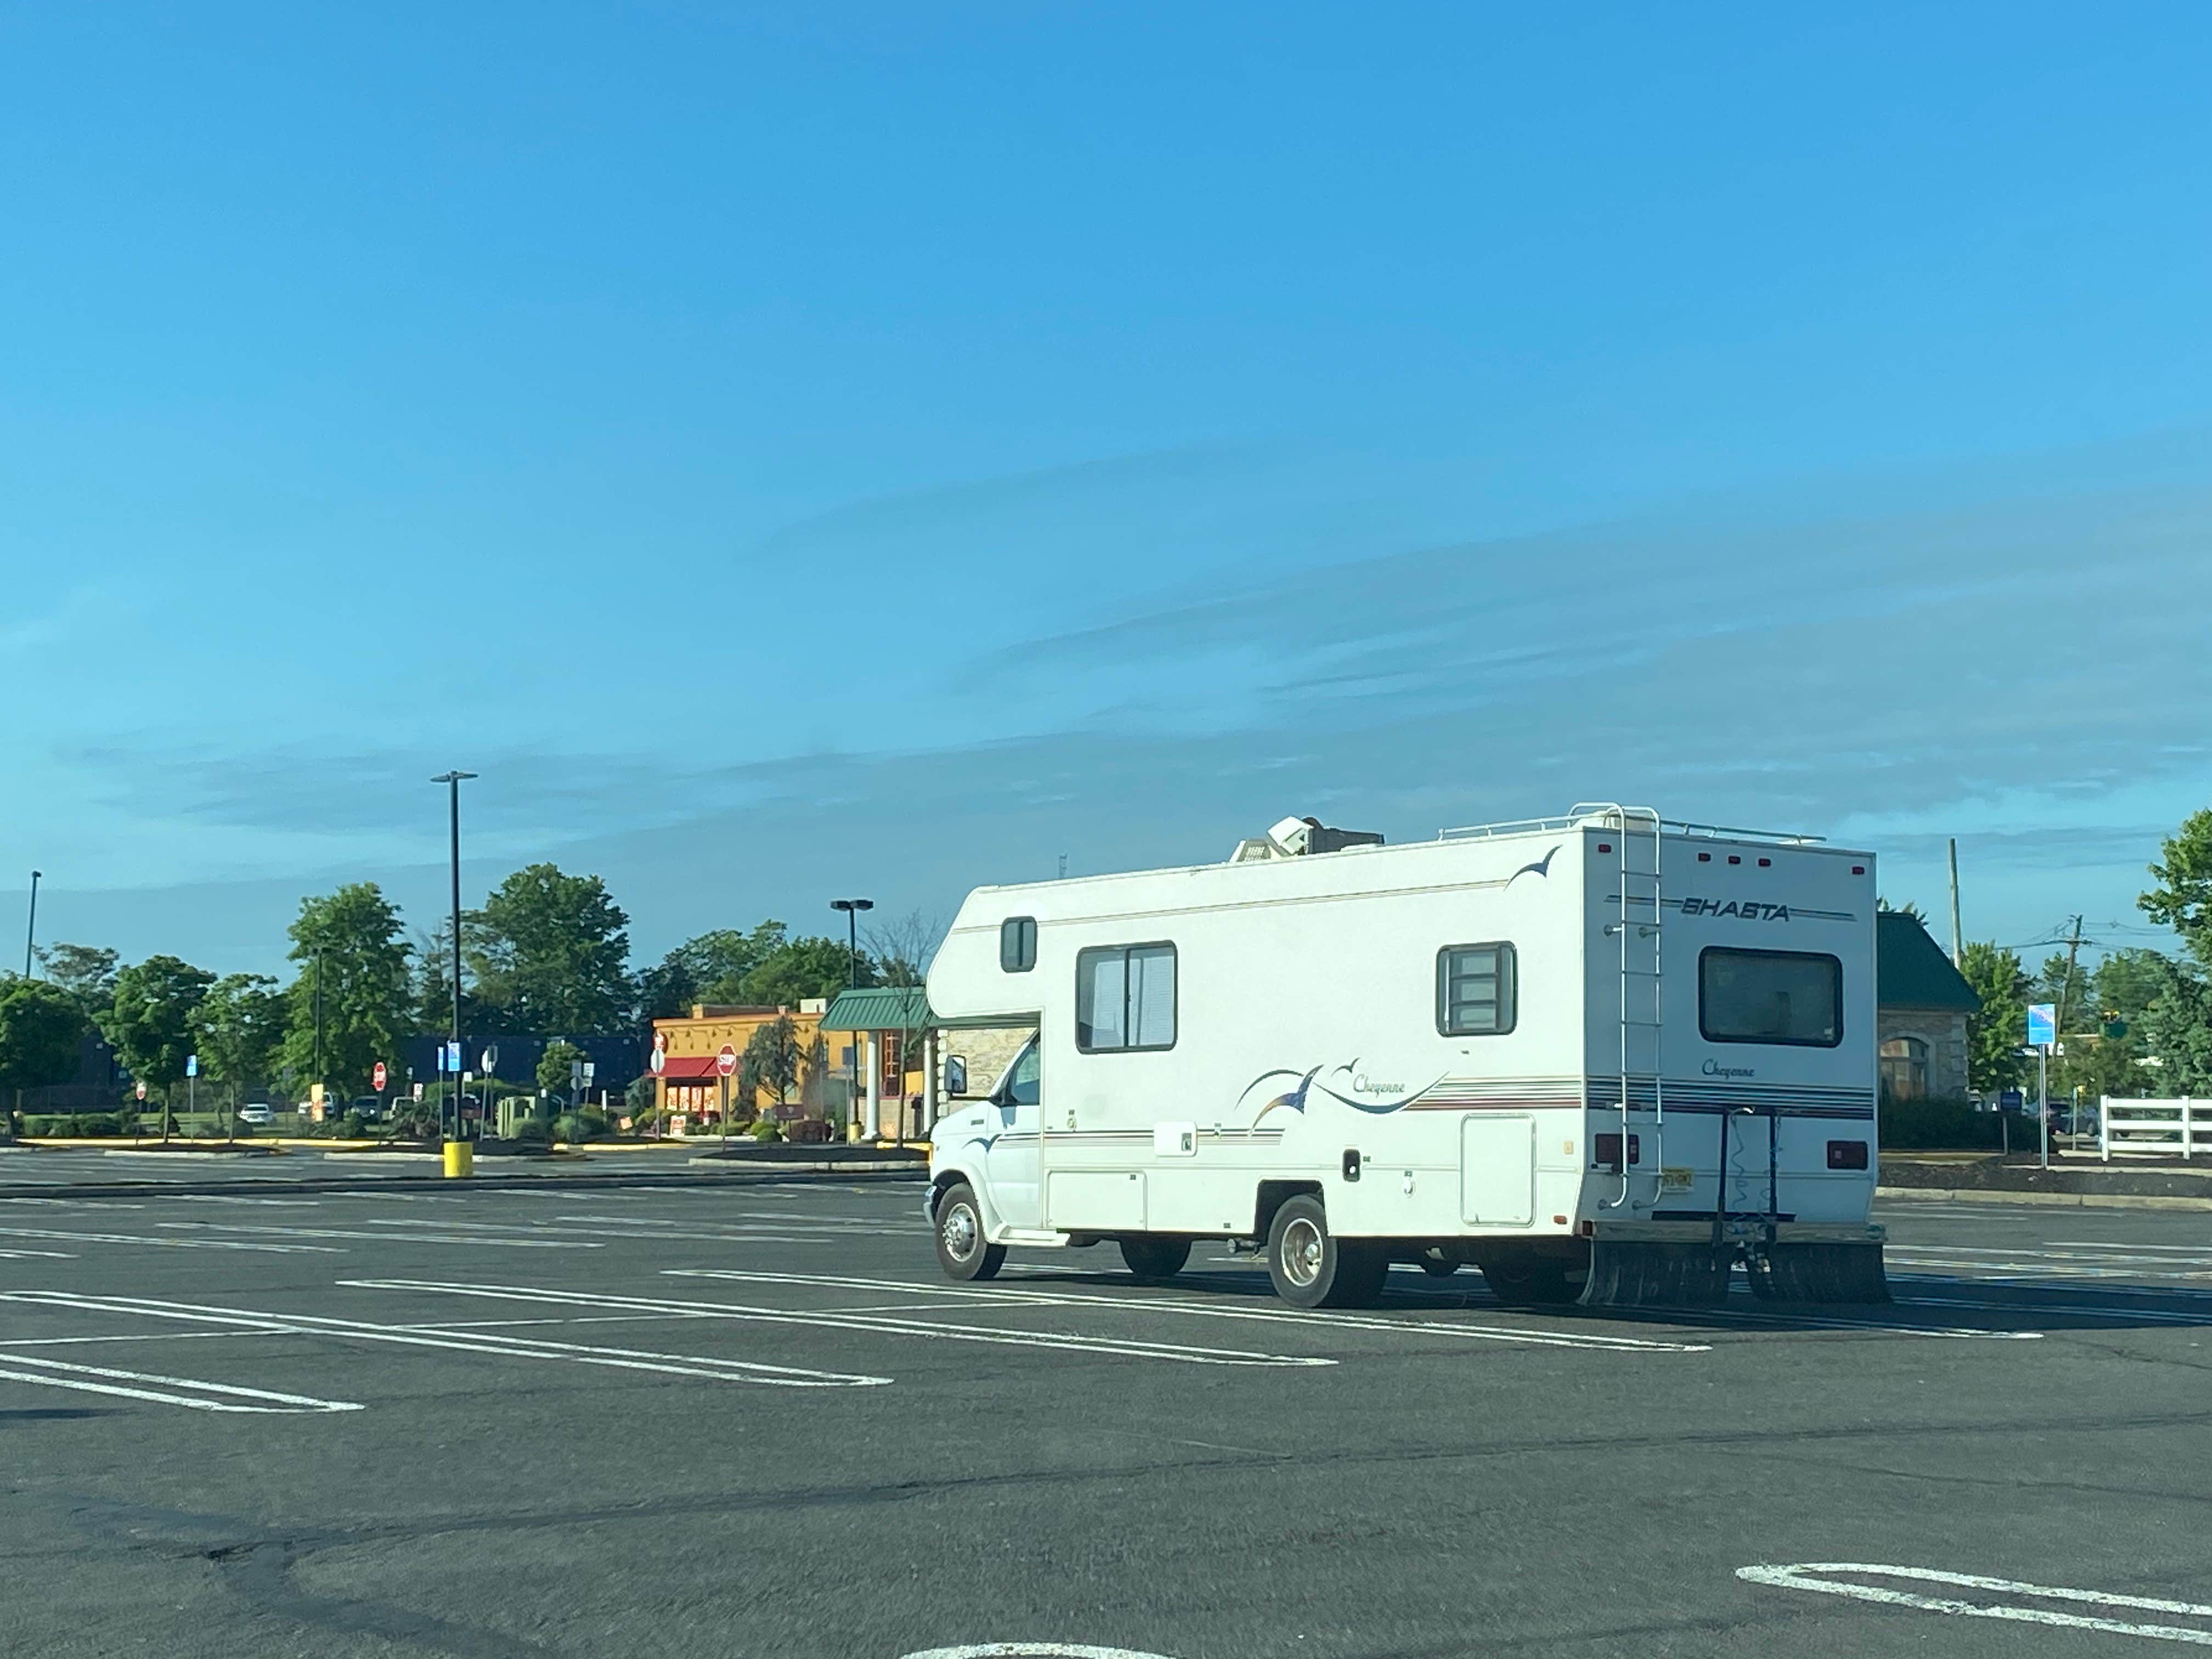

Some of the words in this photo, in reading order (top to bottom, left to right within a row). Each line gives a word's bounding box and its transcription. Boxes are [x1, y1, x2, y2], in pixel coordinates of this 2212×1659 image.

[1681, 897, 1790, 922] SHASTA
[1702, 1058, 1755, 1080] Cheyenne
[1353, 1073, 1406, 1098] Cheyenne
